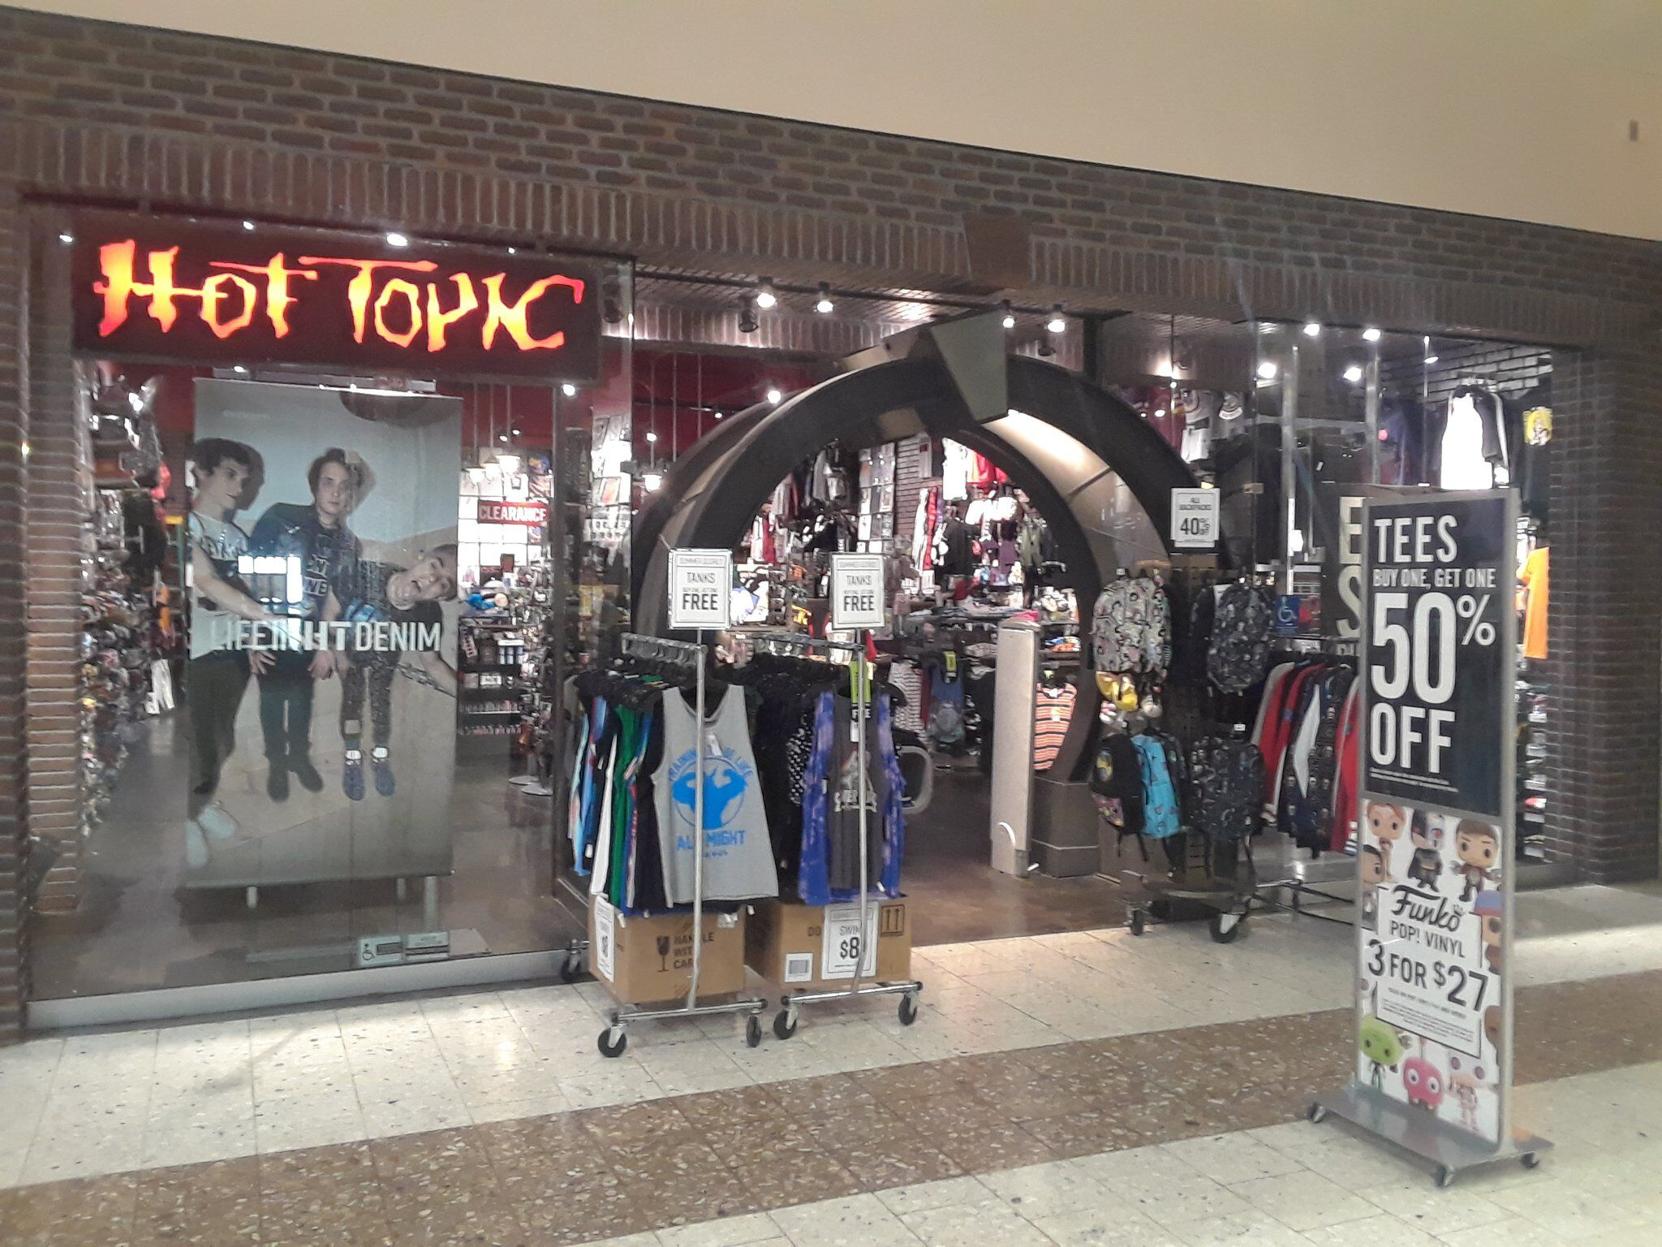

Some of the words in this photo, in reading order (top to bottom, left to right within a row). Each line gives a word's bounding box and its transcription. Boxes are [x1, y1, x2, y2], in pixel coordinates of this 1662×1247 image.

[480, 504, 547, 521] CLEARANCE
[1374, 514, 1458, 564] TEES
[687, 571, 716, 584] TANKS
[1373, 568, 1398, 587] BUY
[1401, 568, 1431, 590] ONE,
[1434, 568, 1462, 588] GET
[1465, 568, 1496, 588] ONE
[682, 593, 719, 610] FREE
[843, 595, 875, 611] FREE
[355, 622, 441, 652] DENIM
[1371, 592, 1496, 704] 50%
[1370, 702, 1456, 773] OFF
[676, 834, 697, 850] AL
[1392, 884, 1461, 932] Funko
[673, 932, 715, 943] HANLE
[840, 937, 860, 959] $8
[1390, 920, 1421, 944] POP!
[1425, 930, 1465, 958] VINYL
[673, 946, 694, 957] WIT
[1368, 938, 1385, 977] 3
[1390, 952, 1427, 989] FOR
[1433, 960, 1489, 1012] $27
